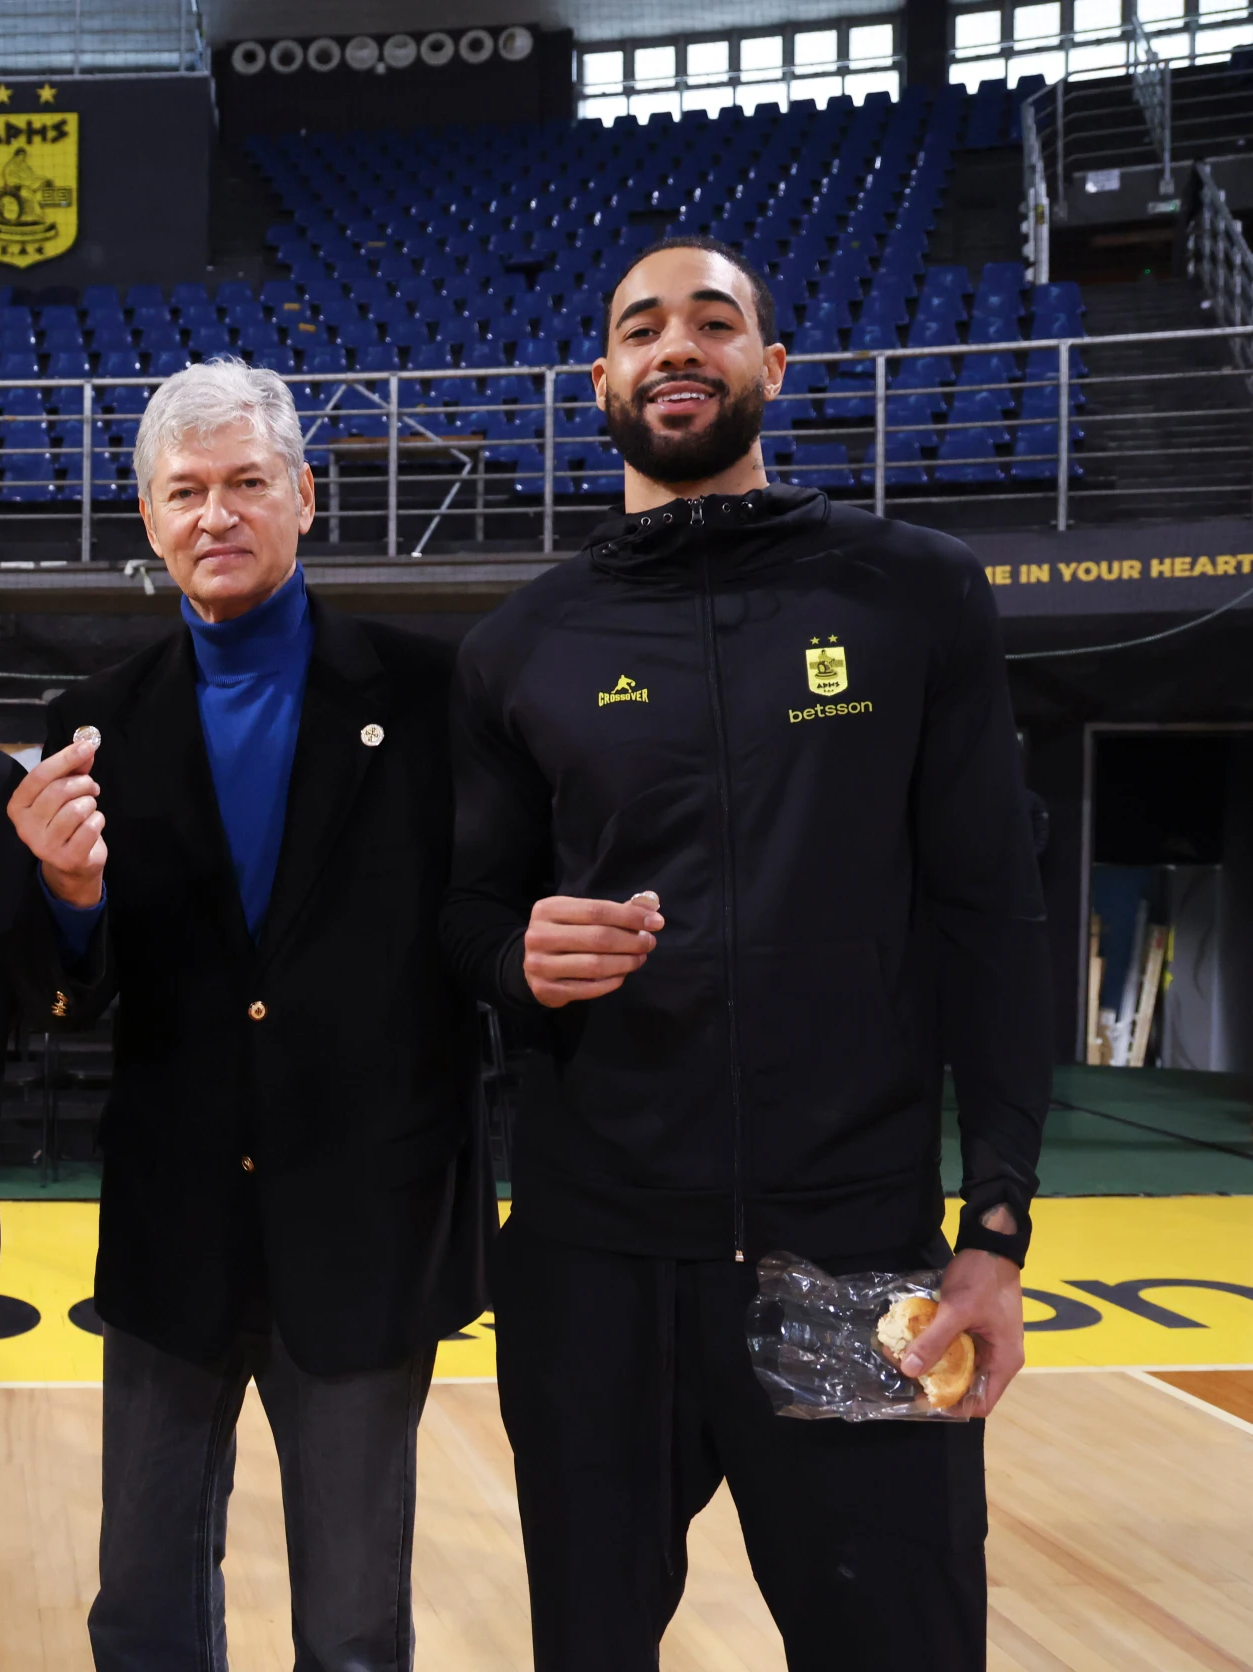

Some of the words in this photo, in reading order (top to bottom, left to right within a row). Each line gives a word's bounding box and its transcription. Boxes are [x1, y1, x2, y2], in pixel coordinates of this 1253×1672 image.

[1019, 563, 1050, 584] IN
[1058, 559, 1143, 583] YOUR
[1149, 553, 1253, 579] HEART
[598, 688, 649, 707] CROSSOVER
[788, 701, 873, 723] betsson
